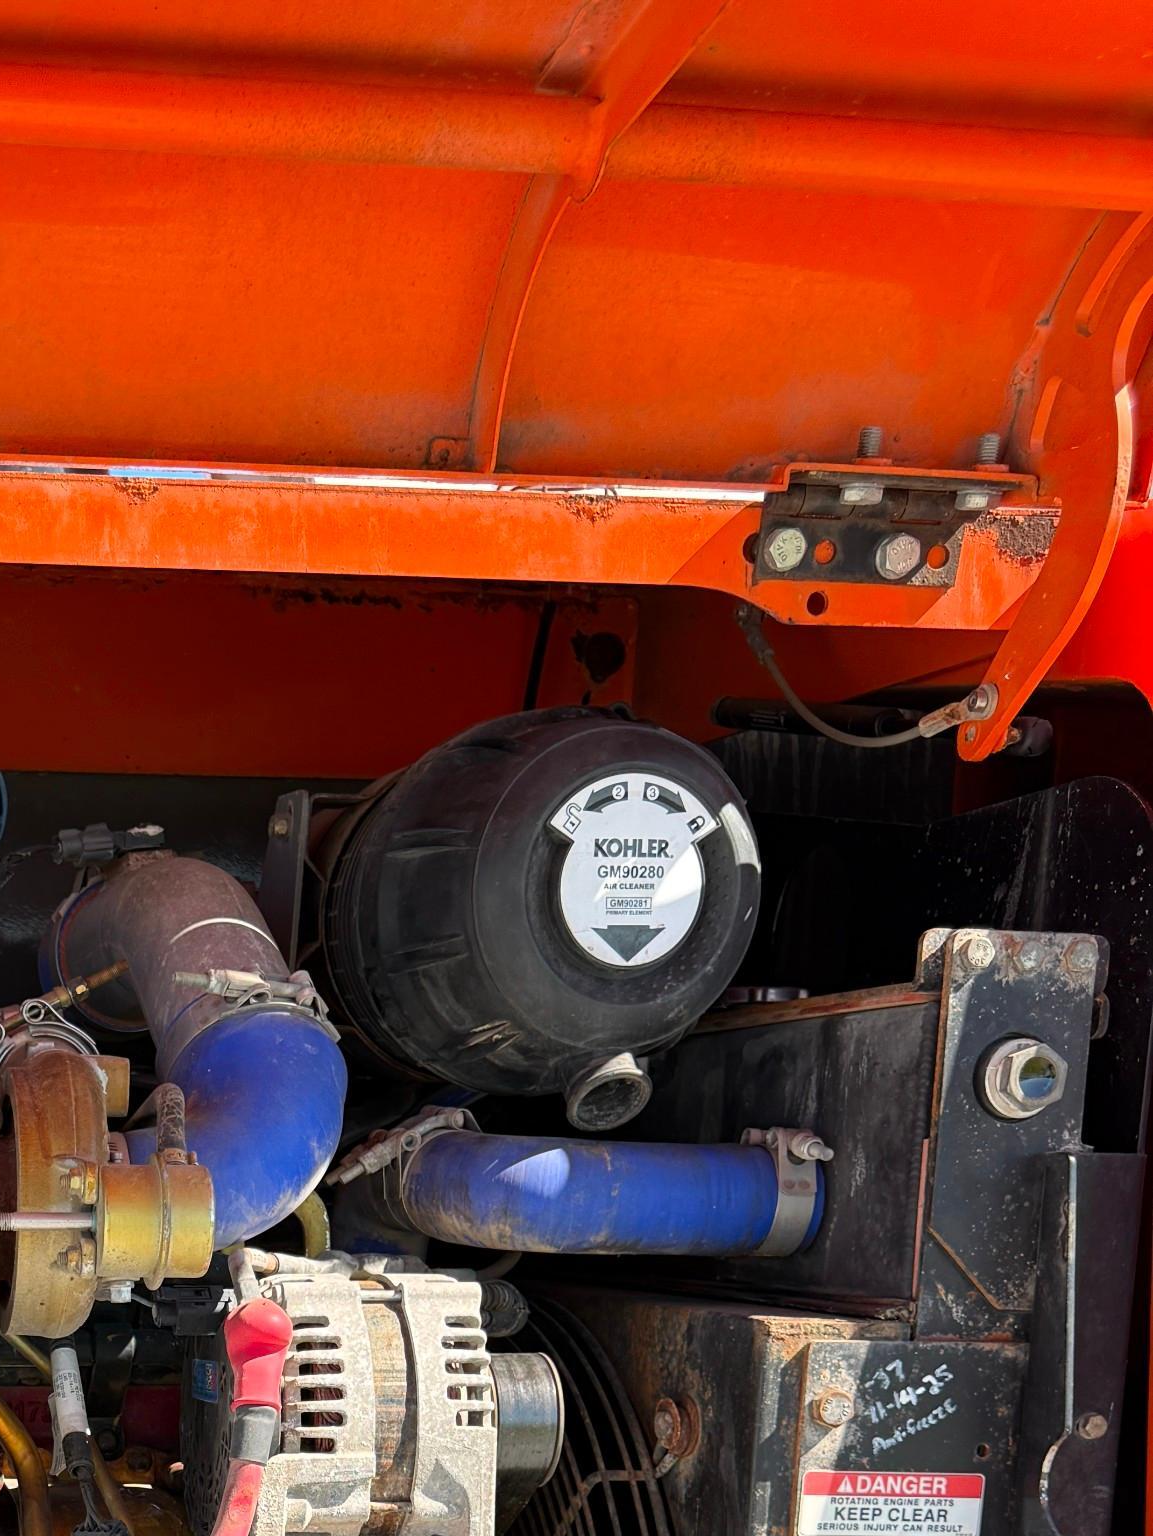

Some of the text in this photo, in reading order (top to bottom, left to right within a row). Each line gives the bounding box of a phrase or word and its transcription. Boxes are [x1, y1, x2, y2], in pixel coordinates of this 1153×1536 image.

[615, 785, 622, 797] 2
[649, 786, 657, 798] 3
[593, 838, 670, 858] KOHLER
[597, 865, 664, 879] GM90280
[609, 900, 648, 908] GM90281
[856, 1476, 947, 1495] DANGER
[830, 1497, 954, 1507] ROTATING ENGINE PARTS
[834, 1507, 948, 1522] KEEP CLEAR
[817, 1523, 963, 1533] SERIOUS INJURY CAN RESULT
